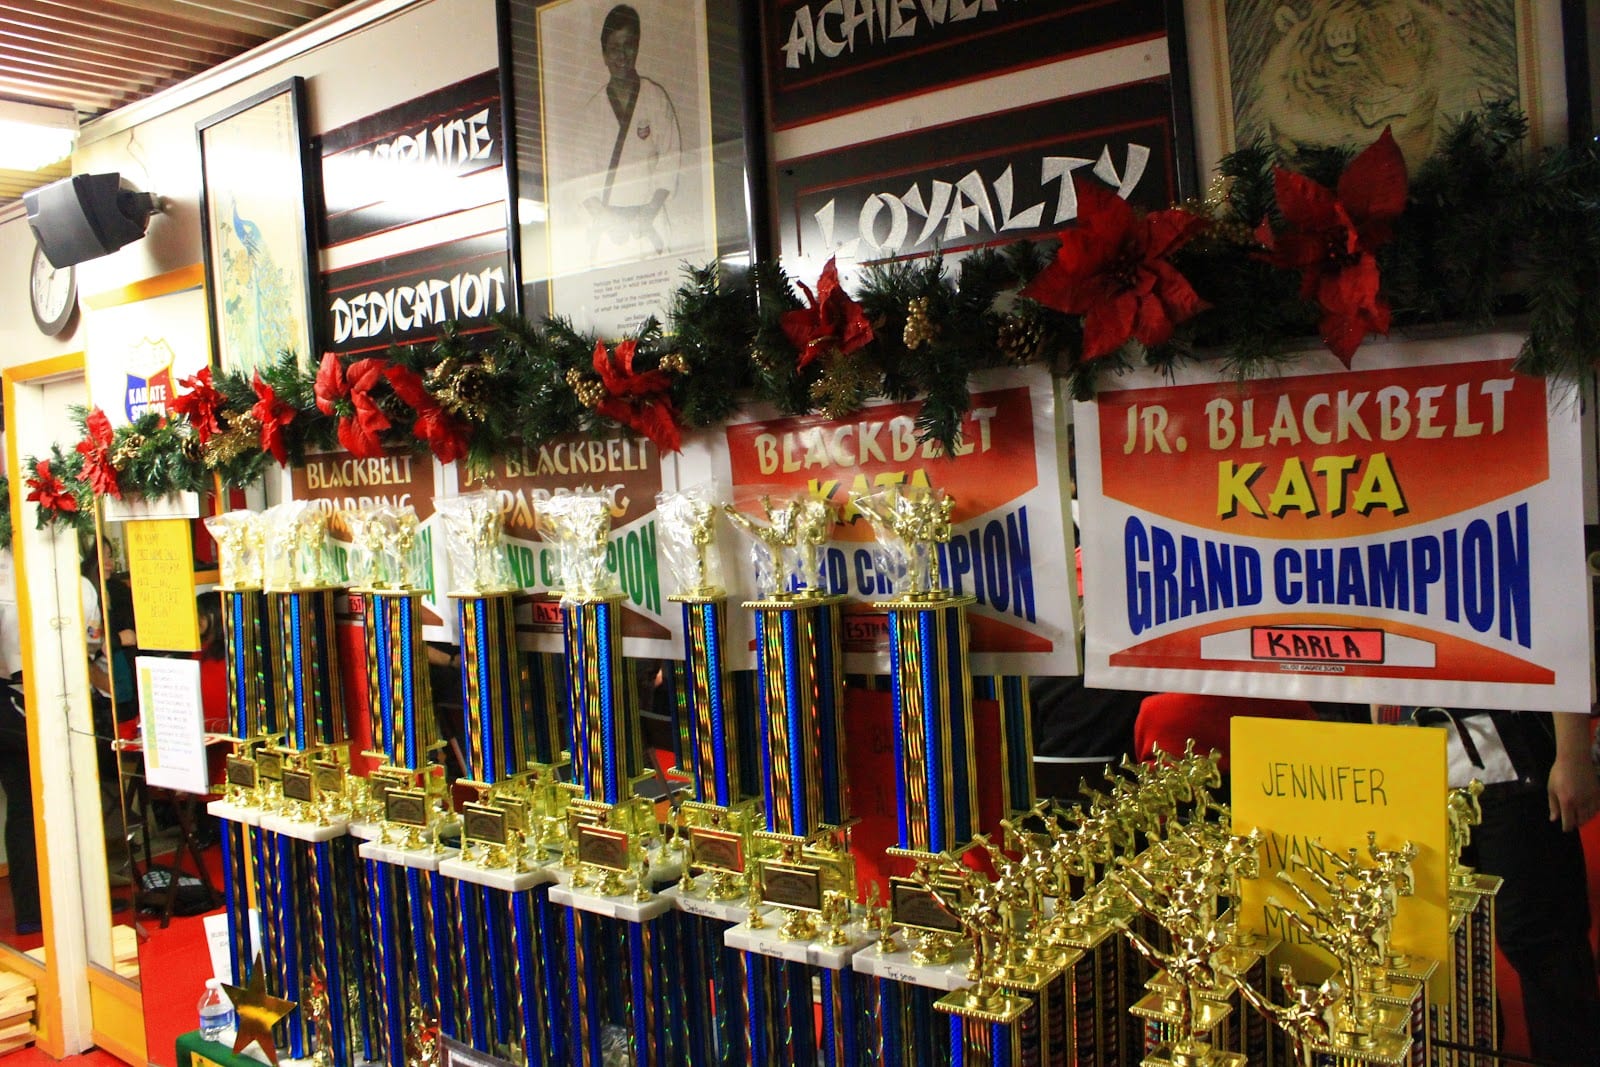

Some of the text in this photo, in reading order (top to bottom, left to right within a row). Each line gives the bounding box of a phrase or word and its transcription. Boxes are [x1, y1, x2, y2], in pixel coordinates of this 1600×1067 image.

[814, 143, 1151, 263] LOYALTY
[330, 266, 506, 344] DEDICATION
[1123, 378, 1515, 455] JR. BLACKBELT
[307, 455, 412, 489] BLACKBELT
[505, 436, 650, 479] BLACKBELT
[1217, 452, 1406, 519] KATA
[1124, 502, 1532, 649] GRAND CHAMPION
[1267, 631, 1361, 658] KARLA
[1261, 762, 1388, 806] JENNIFER
